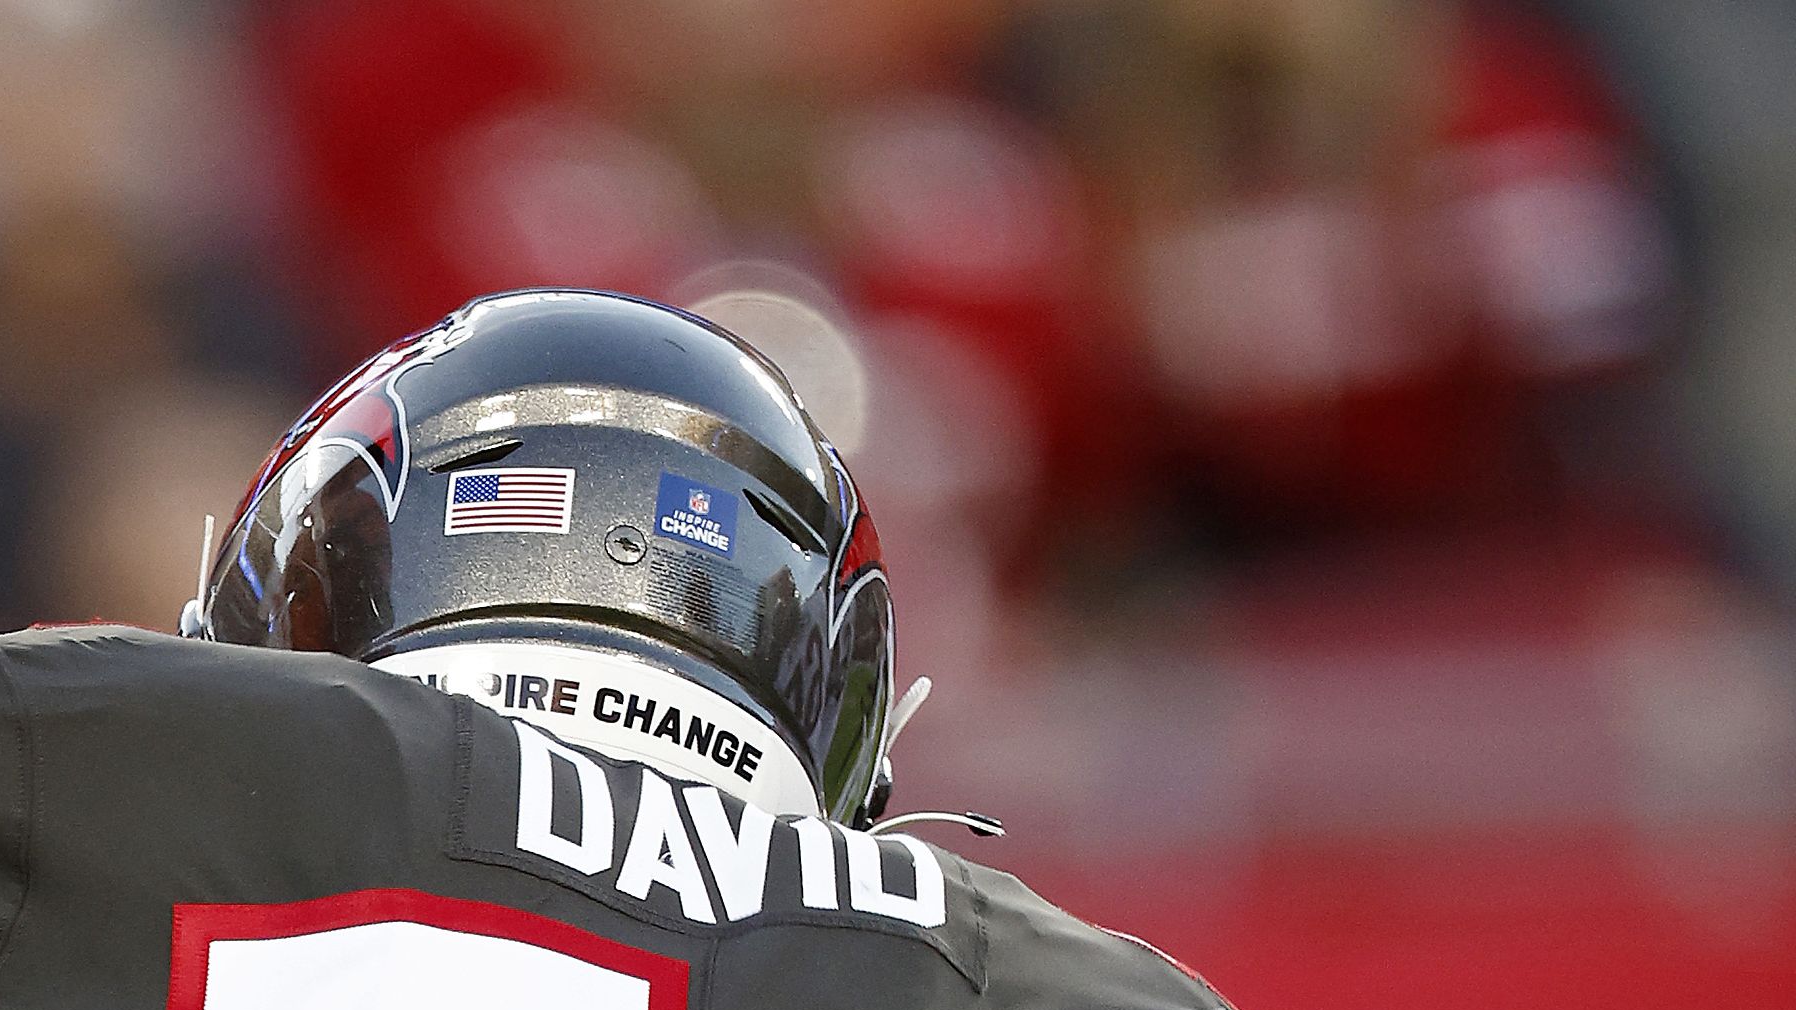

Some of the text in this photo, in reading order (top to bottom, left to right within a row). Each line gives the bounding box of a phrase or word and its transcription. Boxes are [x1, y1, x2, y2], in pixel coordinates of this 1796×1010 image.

[661, 516, 729, 551] CHANGE
[674, 510, 721, 533] INSPIRE
[592, 688, 763, 782] CHANGE
[514, 720, 946, 928] DAVID
